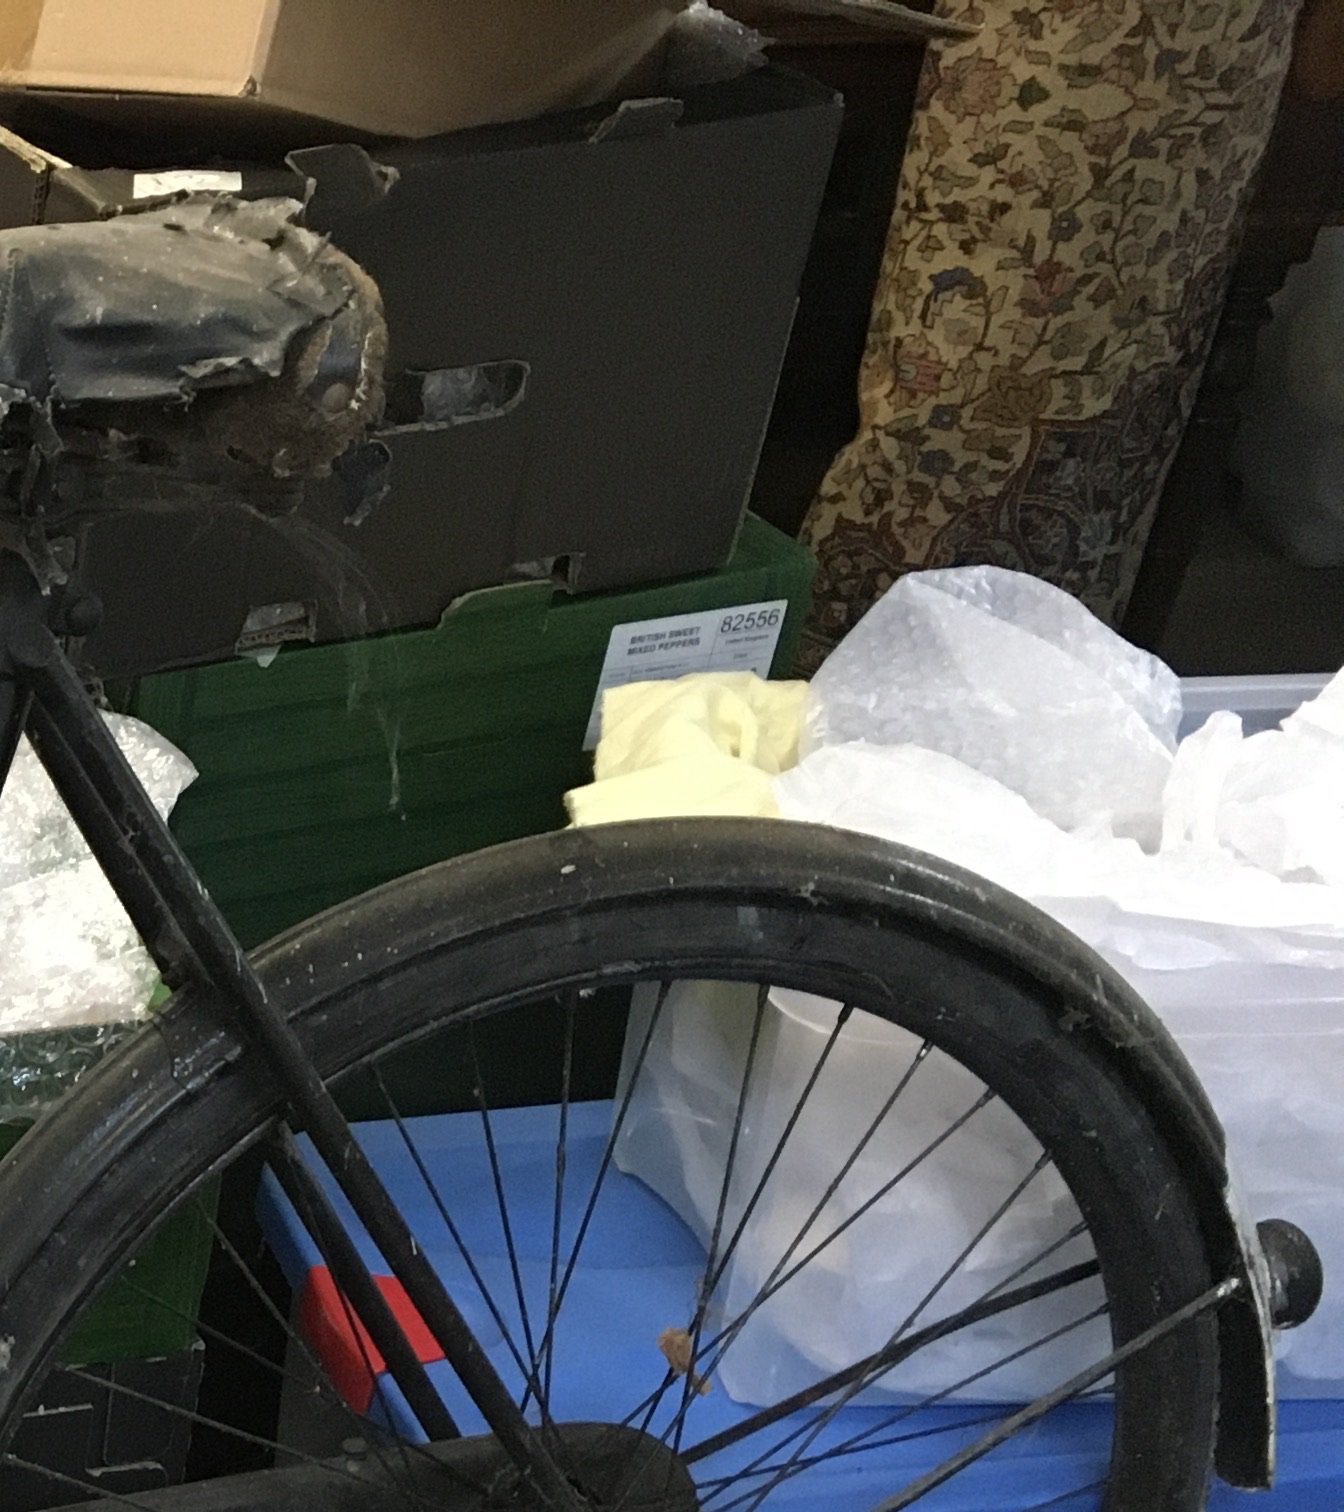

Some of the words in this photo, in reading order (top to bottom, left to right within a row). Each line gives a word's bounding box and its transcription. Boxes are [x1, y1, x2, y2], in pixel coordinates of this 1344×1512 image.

[720, 608, 781, 633] 82556
[630, 632, 666, 645] BRITISH
[668, 626, 701, 639] SWEET
[627, 643, 657, 656] MIXED
[657, 637, 701, 651] PEPPERS
